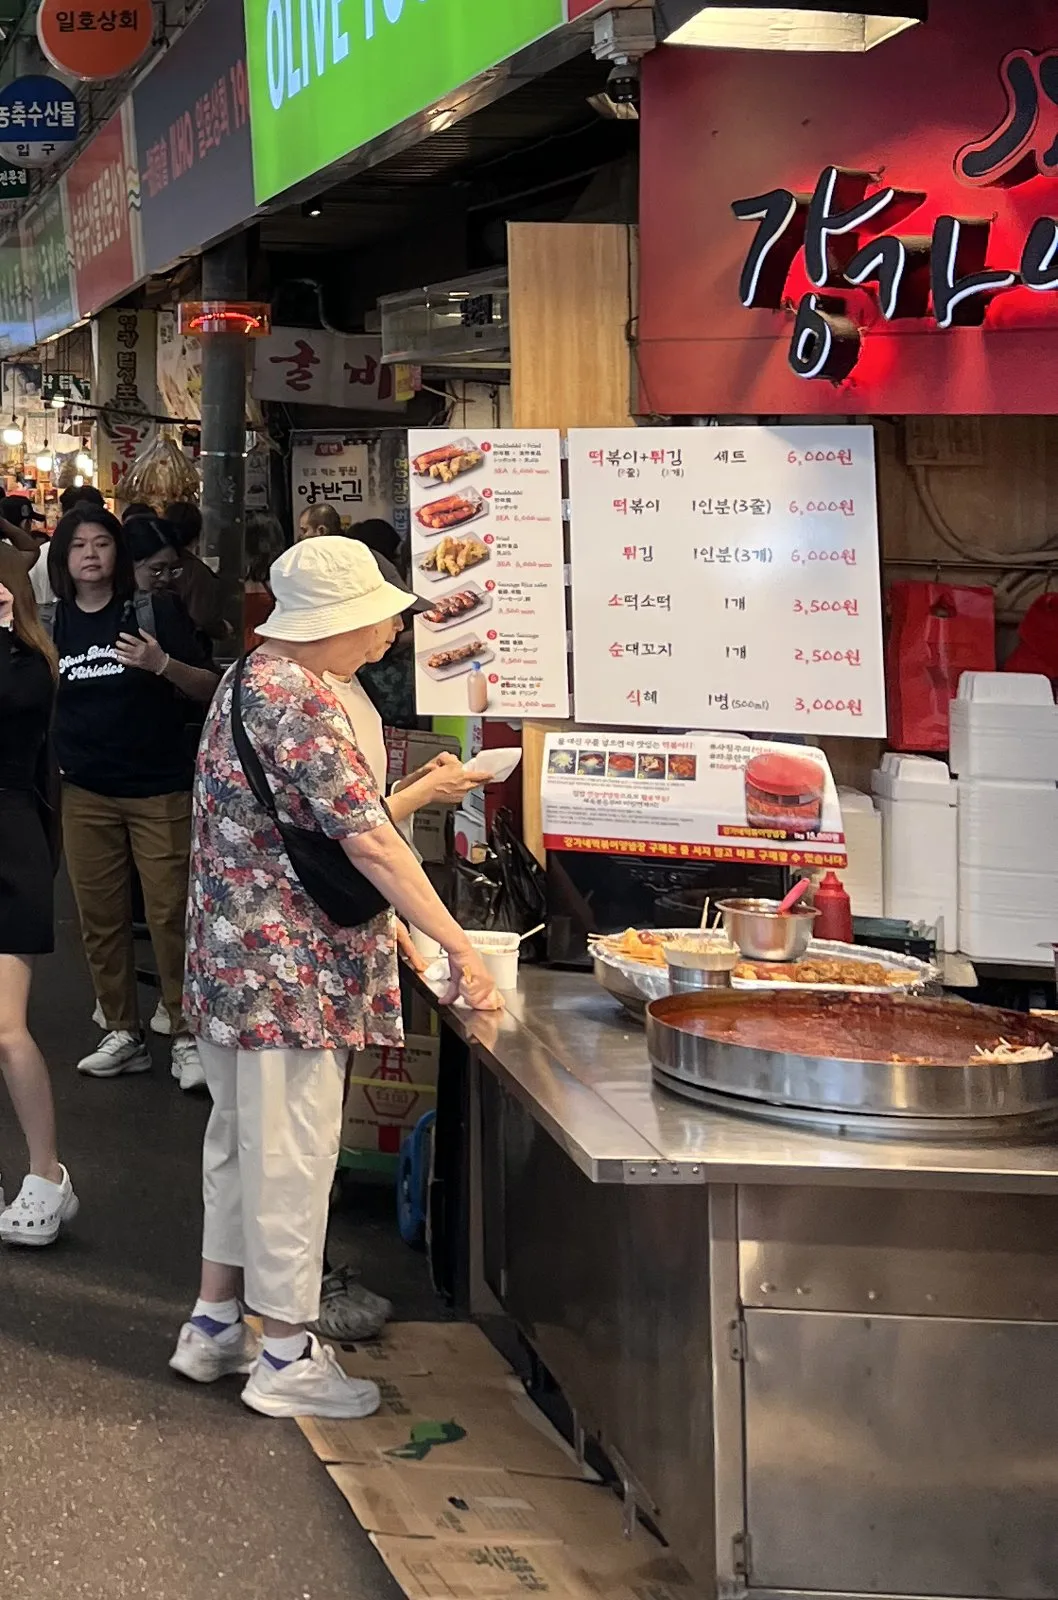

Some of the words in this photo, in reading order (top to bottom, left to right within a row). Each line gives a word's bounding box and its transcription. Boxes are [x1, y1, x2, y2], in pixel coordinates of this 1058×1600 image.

[56, 10, 138, 32] 일호상회
[0, 100, 76, 128] 농축수산물
[731, 165, 1058, 378] 강가
[588, 449, 682, 466] 떡볶이+튀김
[714, 450, 747, 464] 세트
[787, 449, 854, 466] 6,000원
[298, 479, 363, 504] 양반김
[613, 498, 660, 514] 떡볶이
[692, 498, 772, 514] 1인분(3줄)
[789, 498, 855, 516] 6,000원
[622, 546, 653, 562] 튀김
[693, 546, 774, 564] 1인분(3개)
[791, 548, 857, 566] 6,000원
[608, 594, 672, 612] 소떡소떡
[724, 596, 746, 611] 1개
[792, 600, 858, 616] 3,500원
[86, 644, 117, 661] Bala
[608, 642, 672, 658] 순대꼬지
[725, 646, 746, 659] 1개
[794, 648, 860, 666] 2,500원
[67, 662, 126, 681] Athletics
[627, 690, 658, 706] 식혜
[794, 698, 862, 716] 3,000원
